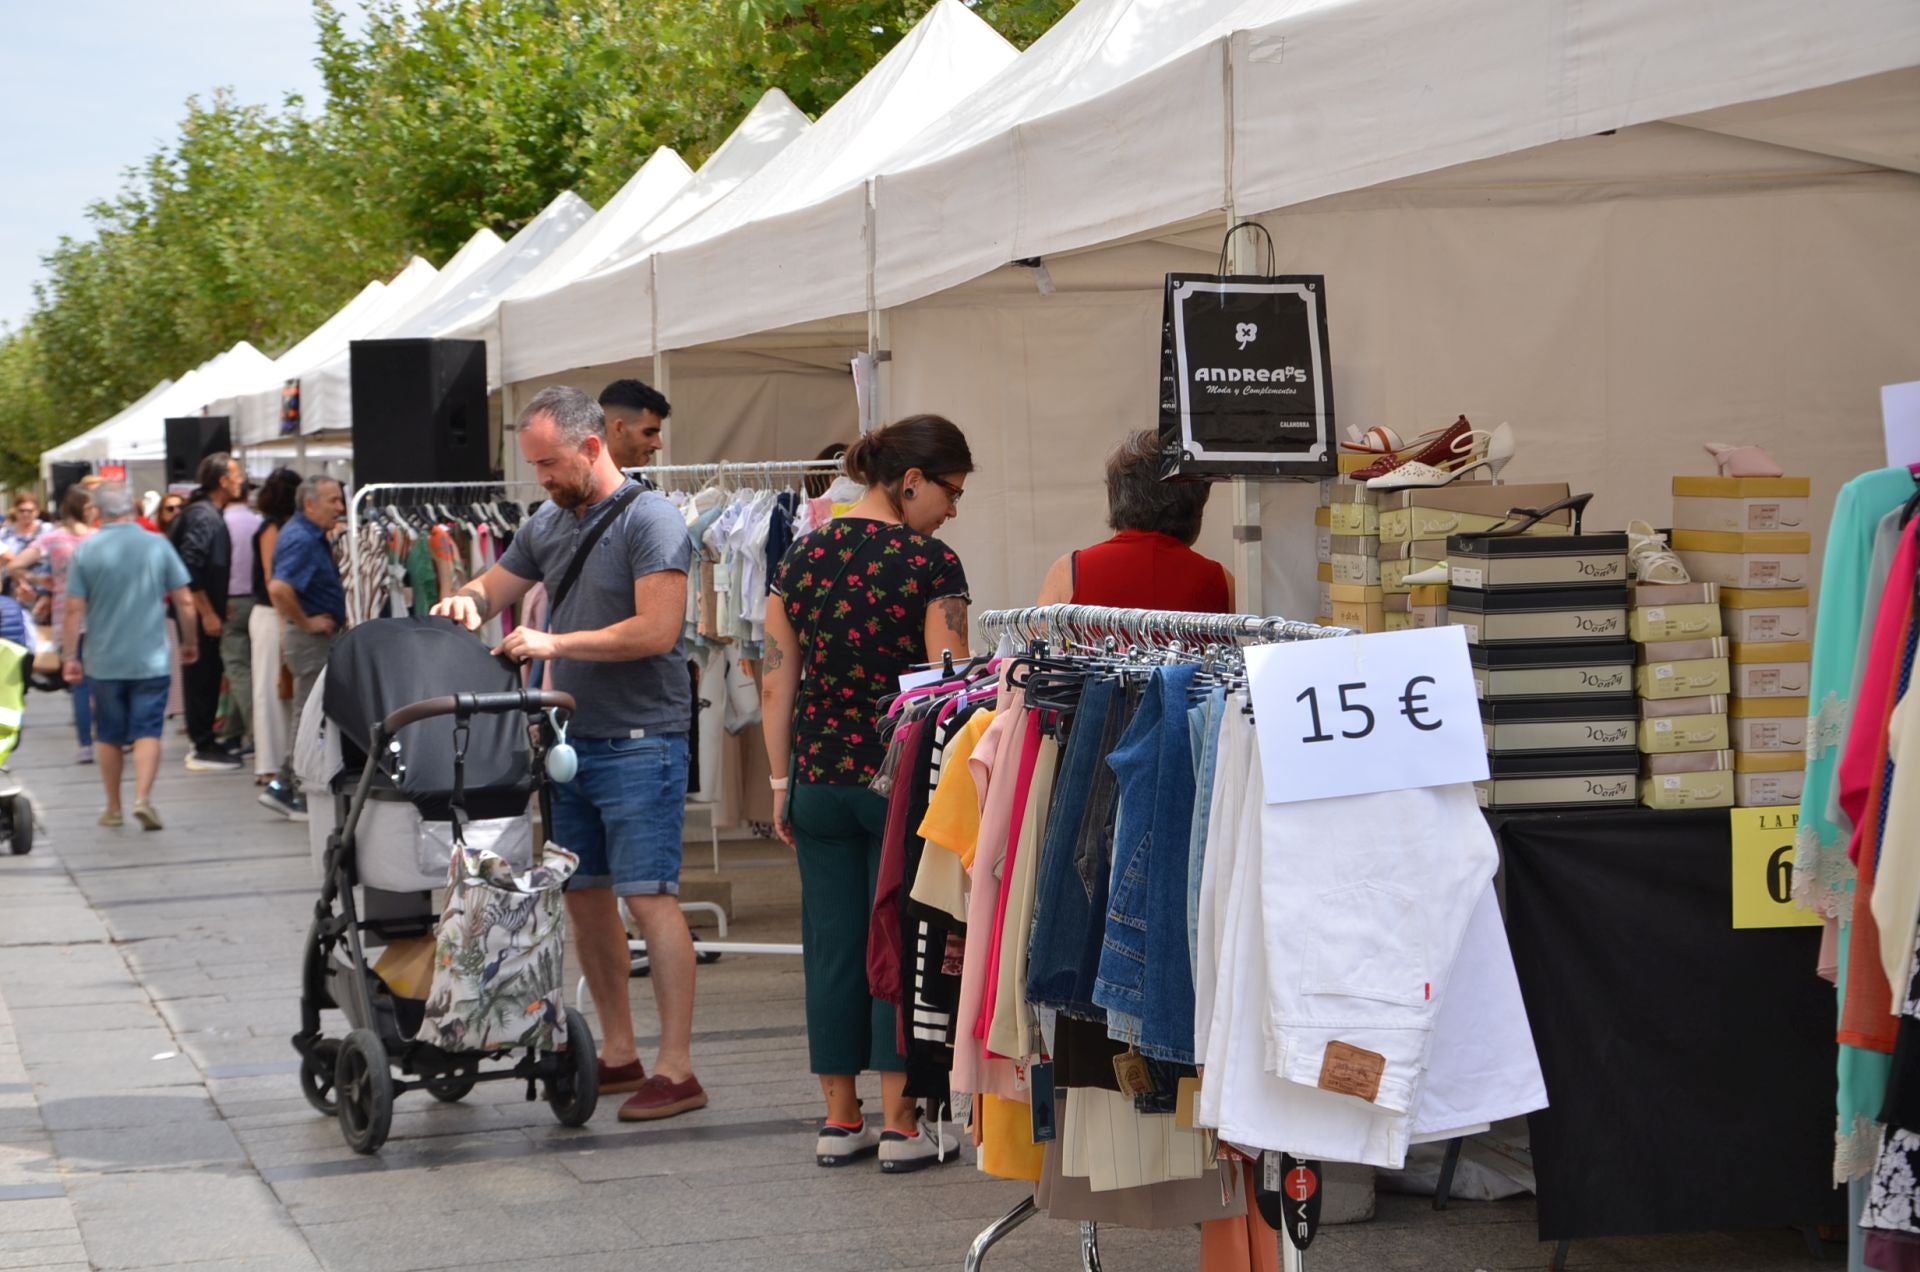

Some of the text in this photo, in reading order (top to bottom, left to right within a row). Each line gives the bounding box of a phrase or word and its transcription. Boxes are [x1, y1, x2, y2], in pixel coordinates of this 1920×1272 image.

[1206, 385, 1297, 396] Moda y Complementos
[1296, 675, 1443, 743] 15 €
